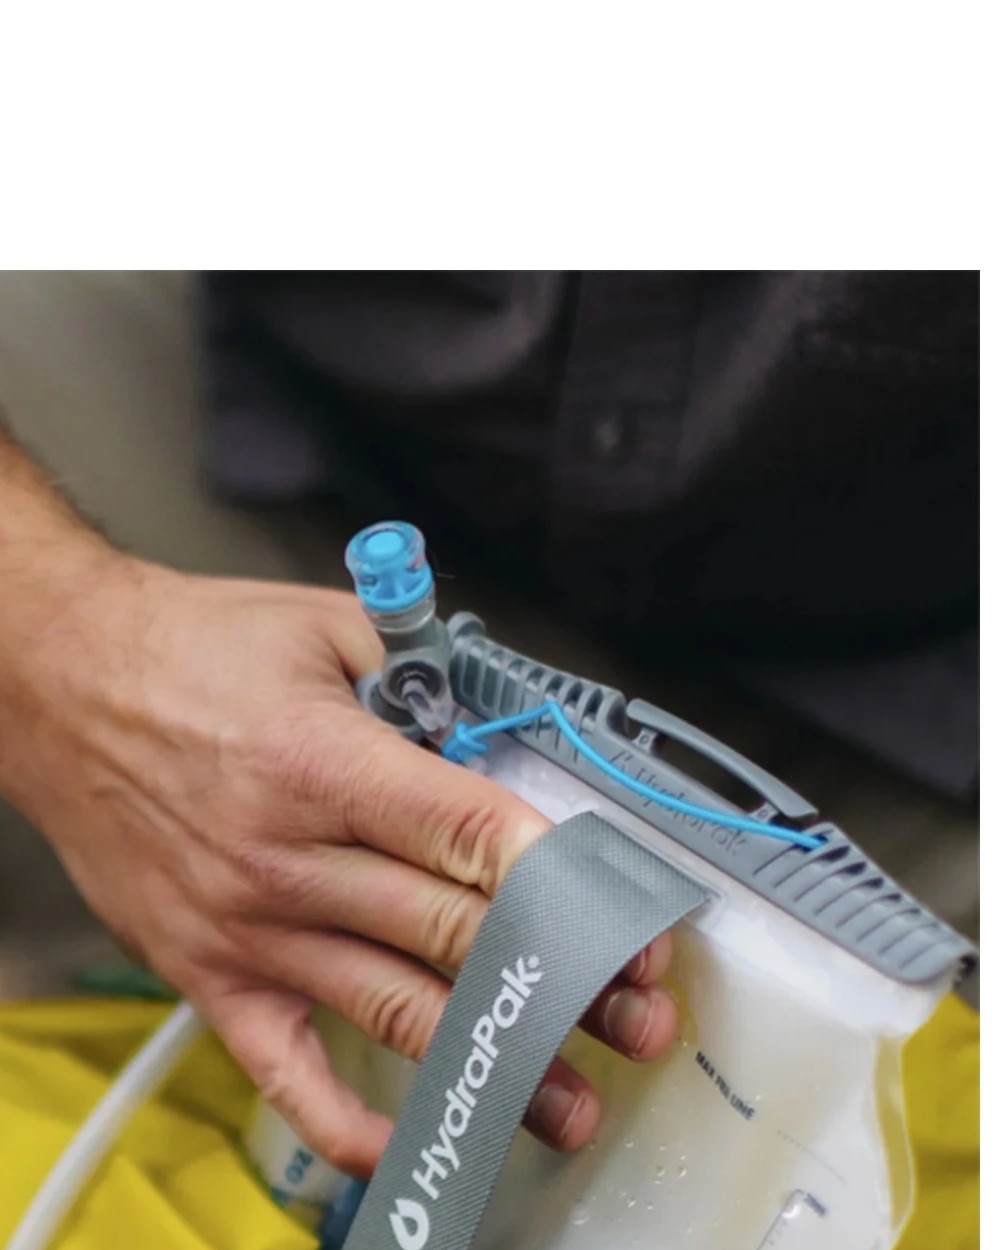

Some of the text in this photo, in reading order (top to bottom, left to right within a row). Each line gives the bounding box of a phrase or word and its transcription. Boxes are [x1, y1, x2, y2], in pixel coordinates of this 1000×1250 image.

[411, 956, 543, 1200] HydraPak
[695, 1051, 715, 1079] MAX
[730, 1094, 755, 1120] LINE
